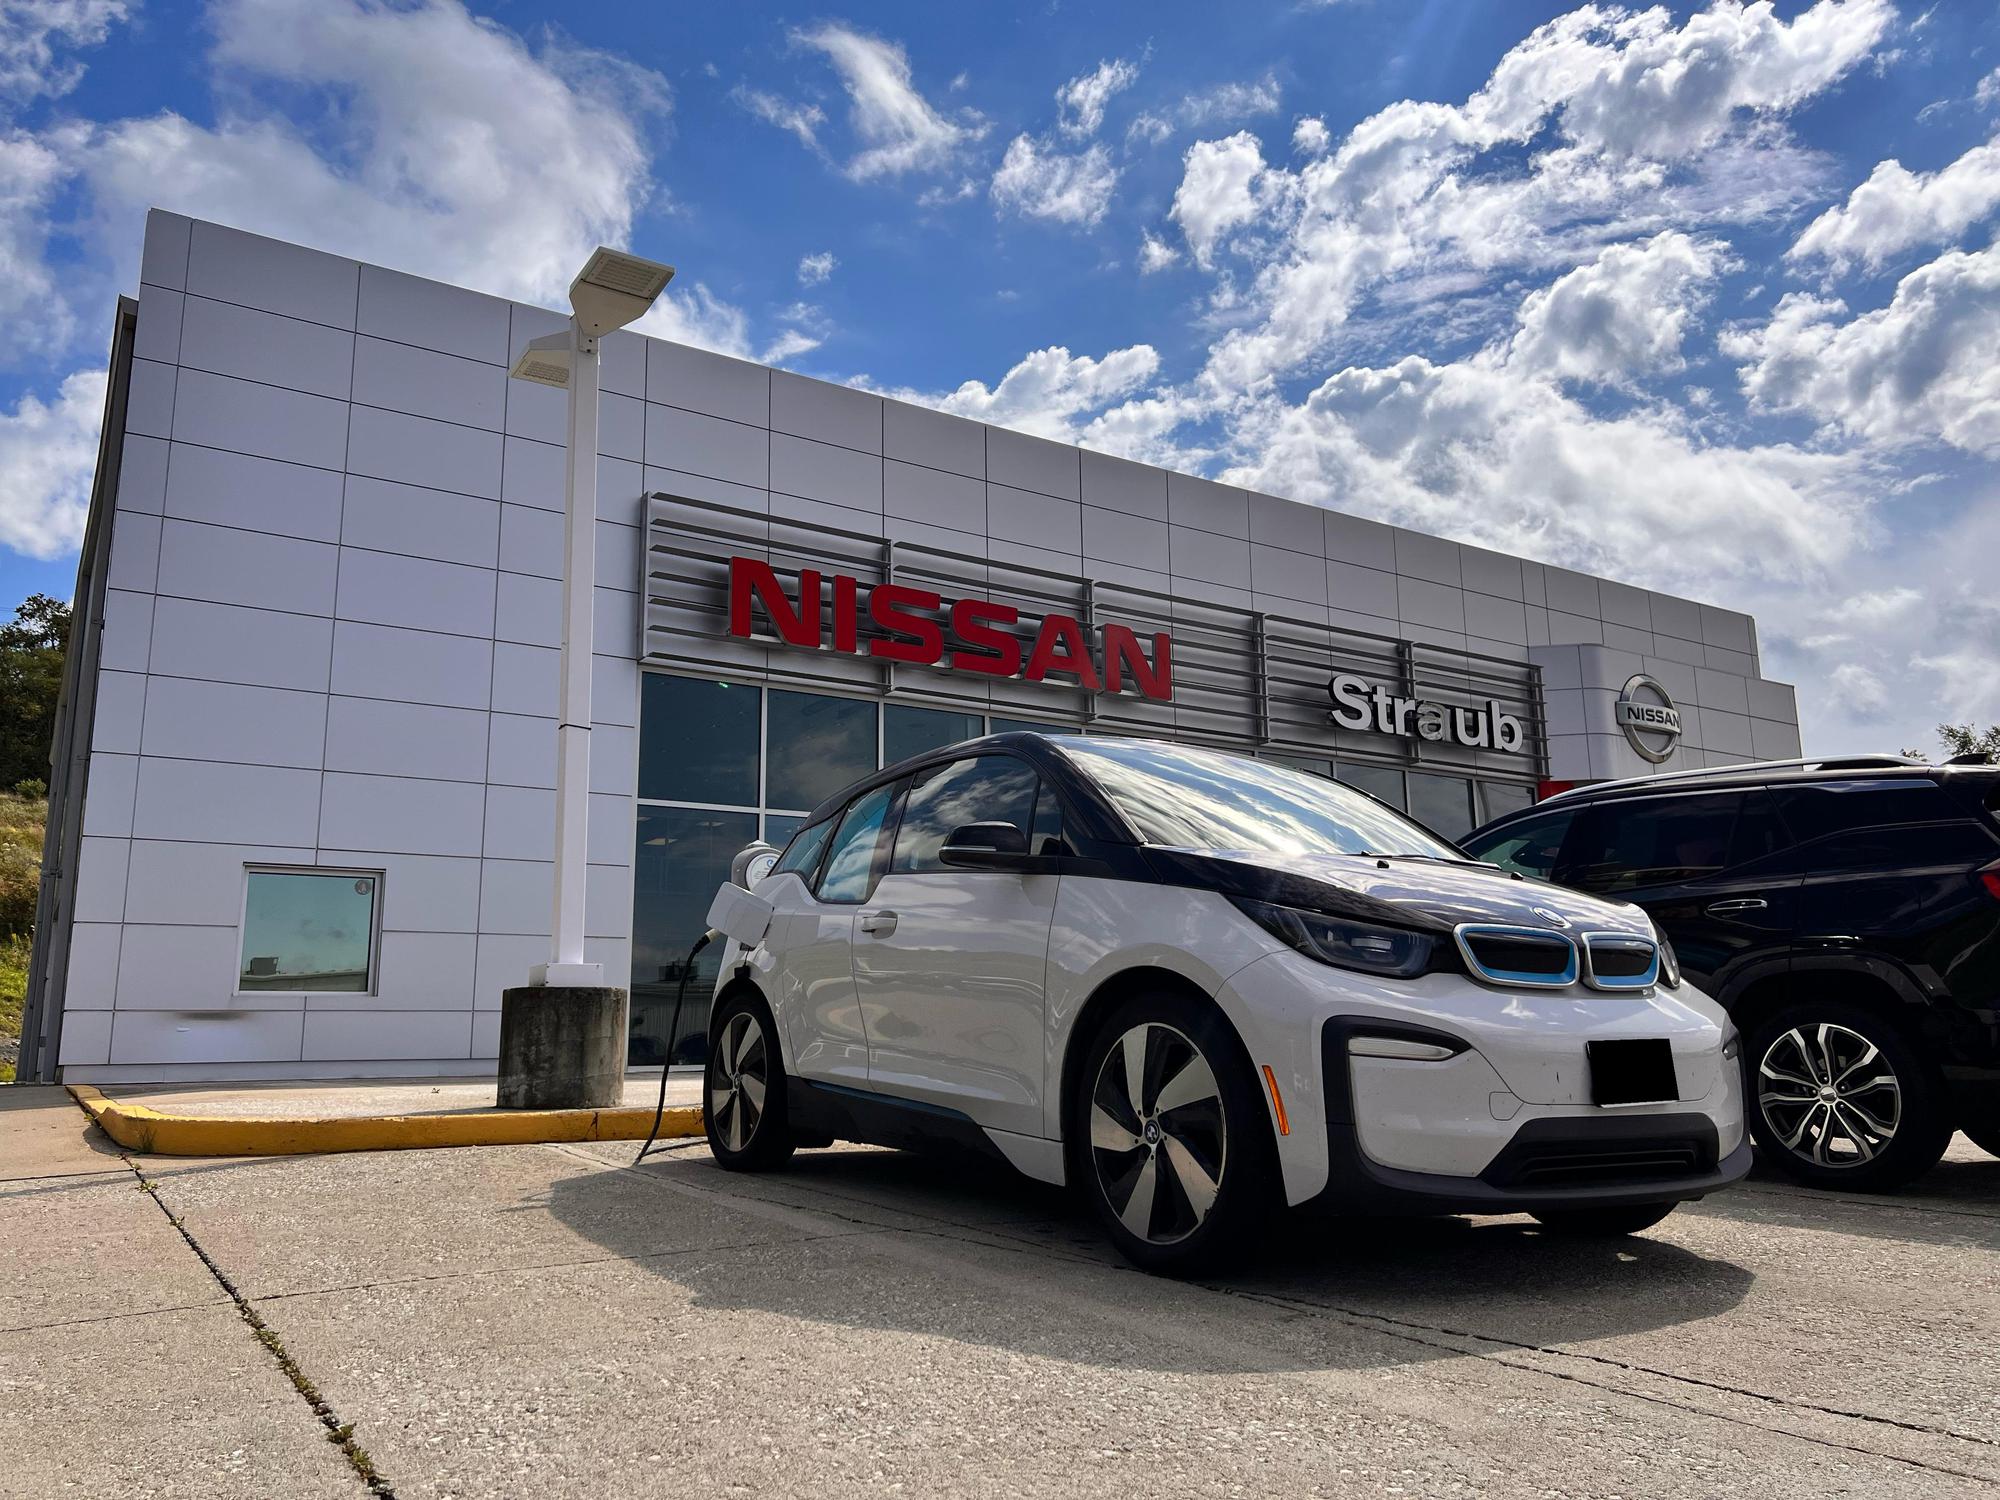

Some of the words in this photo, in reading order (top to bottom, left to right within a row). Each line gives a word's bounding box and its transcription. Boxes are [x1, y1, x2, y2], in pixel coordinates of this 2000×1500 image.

[729, 556, 1172, 701] NISSAN
[1329, 674, 1523, 753] Straub
[1627, 706, 1680, 728] NISSAN
